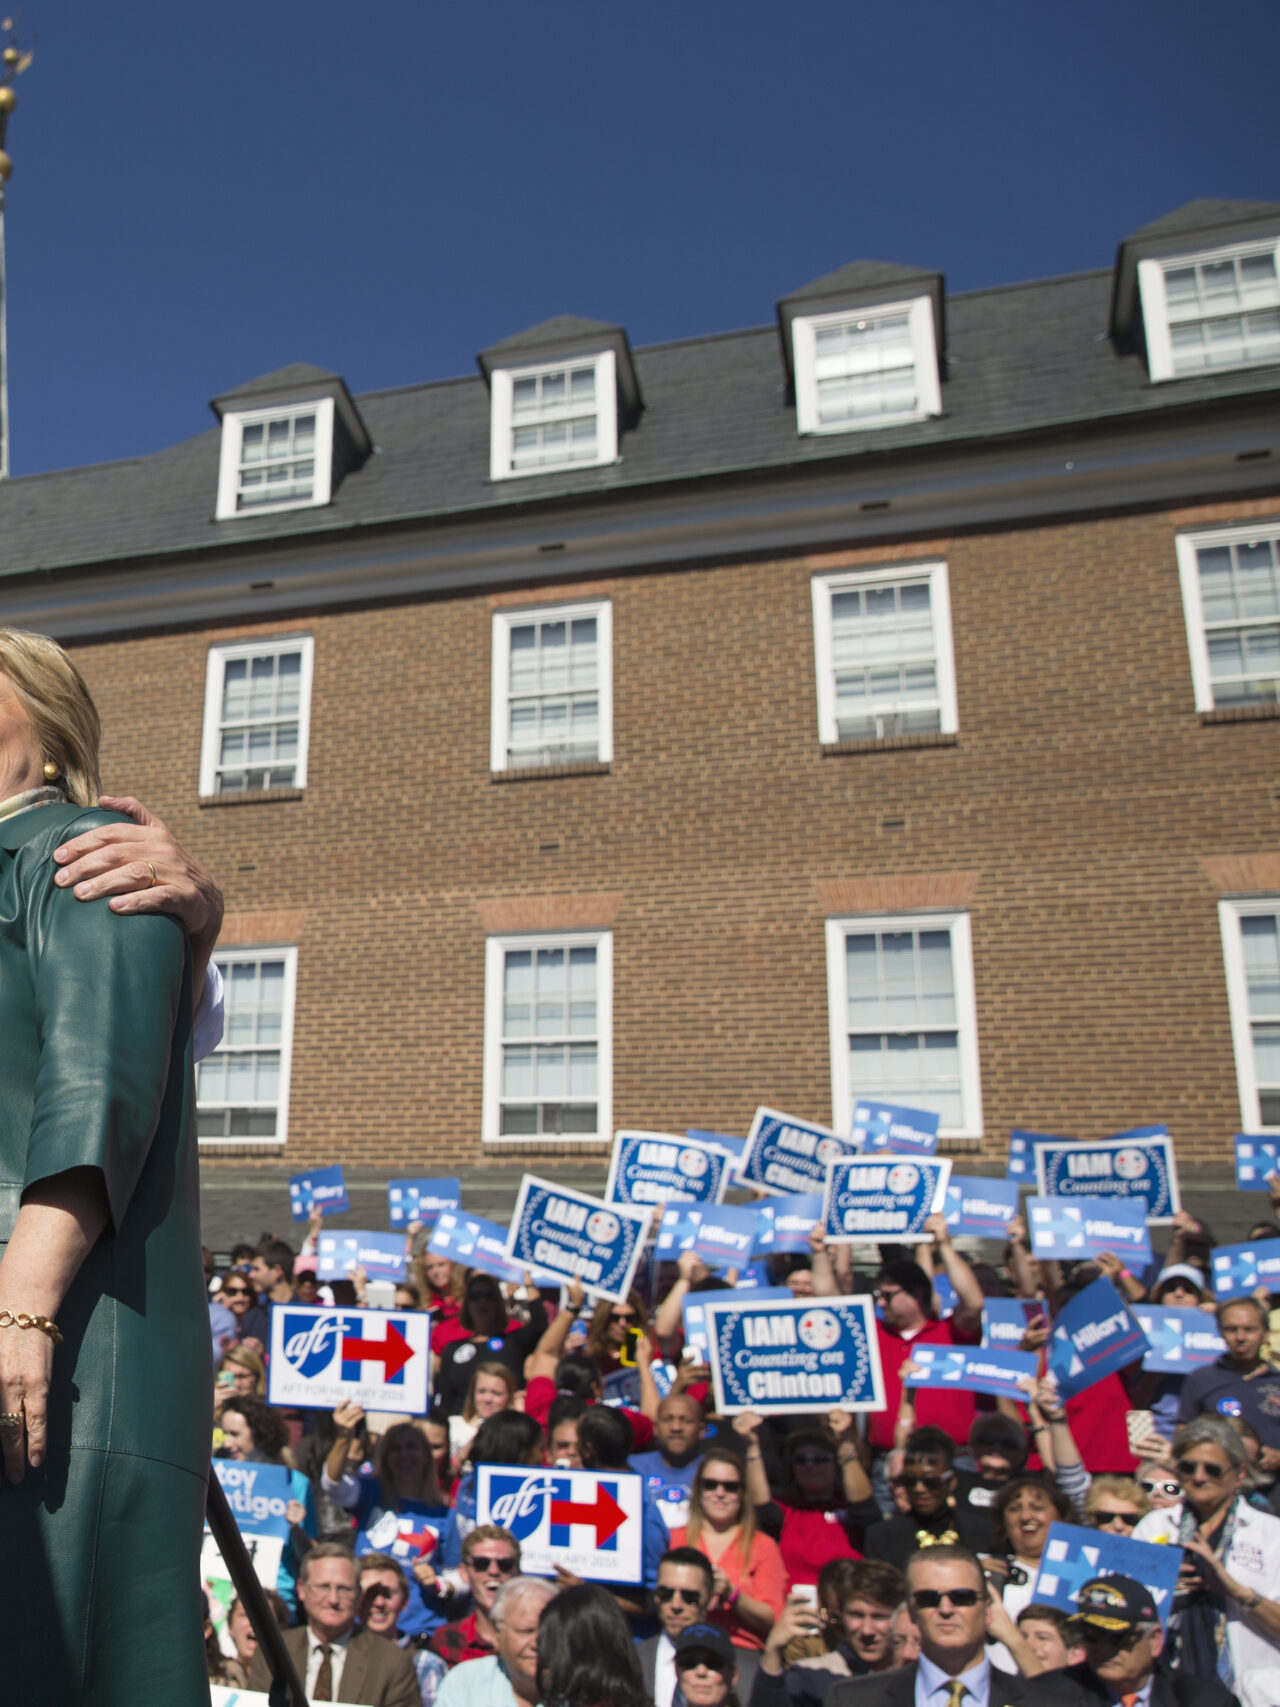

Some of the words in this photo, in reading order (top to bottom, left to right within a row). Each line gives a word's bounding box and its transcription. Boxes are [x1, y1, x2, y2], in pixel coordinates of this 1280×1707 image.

[890, 1123, 935, 1147] Hillary
[1068, 1152, 1112, 1178] IAM
[1059, 1177, 1130, 1196] Counting
[1130, 1179, 1151, 1191] on
[544, 1196, 589, 1233] IAM
[838, 1192, 895, 1210] Counting
[896, 1194, 916, 1206] on
[962, 1199, 1015, 1221] Hillary
[844, 1208, 908, 1231] Clinton
[1085, 1219, 1145, 1244] Hillary
[531, 1219, 593, 1257] Counting
[592, 1245, 613, 1260] on
[698, 1224, 751, 1250] Hillary
[357, 1248, 403, 1268] Hillary
[533, 1238, 603, 1282] Clinton
[285, 1315, 351, 1371] aft
[743, 1315, 798, 1347] IAM
[1071, 1311, 1131, 1352] Hillary
[734, 1348, 819, 1372] Counting
[820, 1351, 845, 1366] on
[747, 1370, 842, 1399] Clinton
[215, 1461, 258, 1497] toy
[229, 1489, 286, 1520] tigo
[492, 1476, 559, 1530] aft
